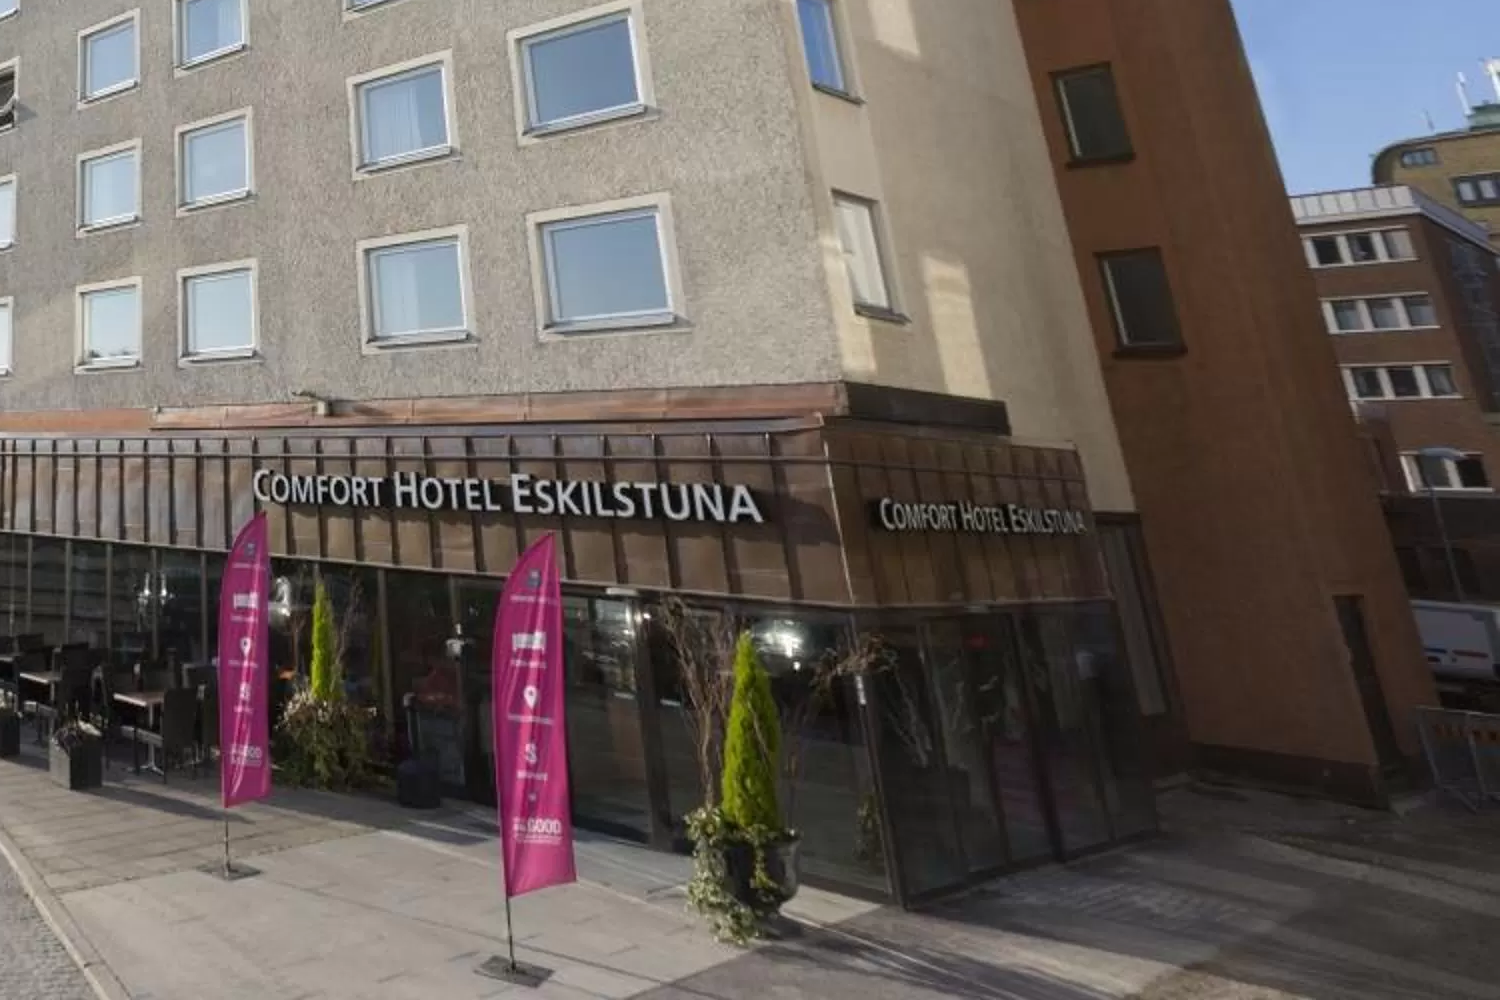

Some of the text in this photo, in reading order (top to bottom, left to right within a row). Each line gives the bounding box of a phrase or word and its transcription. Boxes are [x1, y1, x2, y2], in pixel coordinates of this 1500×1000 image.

[253, 468, 764, 524] COMFORT HOTEL ESKILSTUNA
[879, 497, 1088, 536] COMFORT HOTEL ESKILSTUNA
